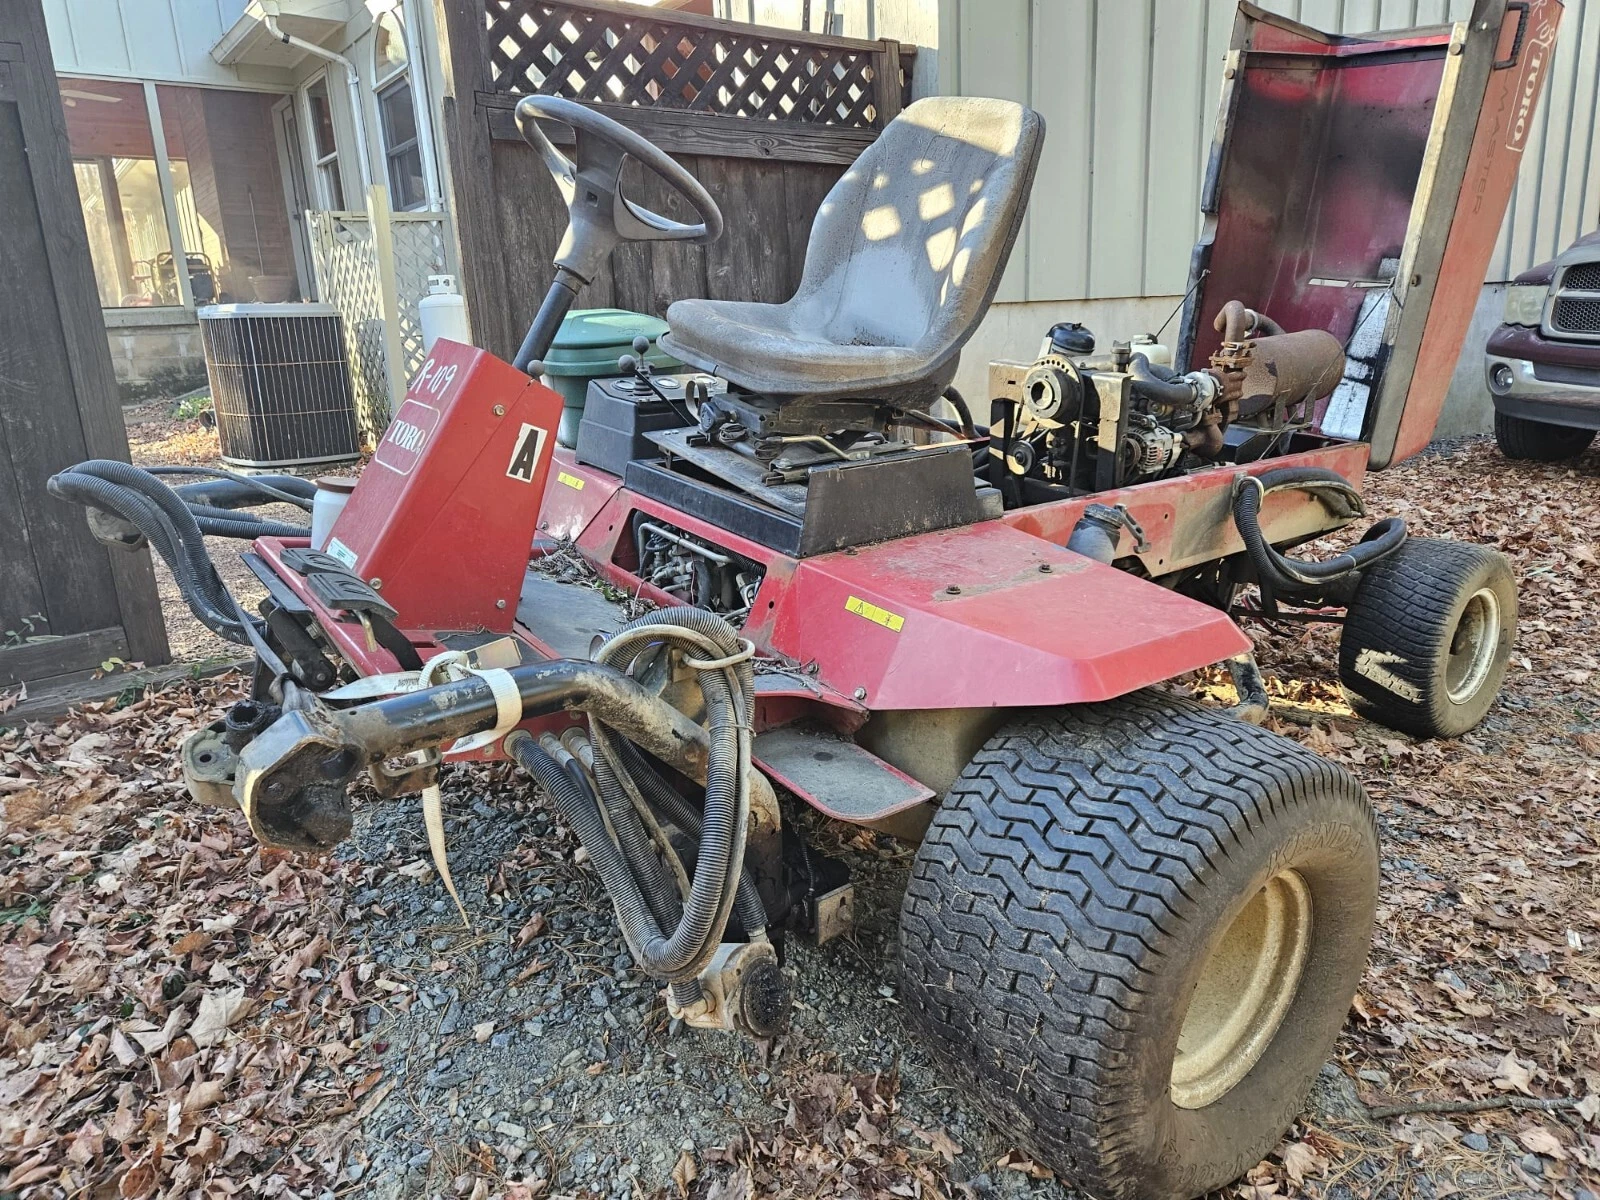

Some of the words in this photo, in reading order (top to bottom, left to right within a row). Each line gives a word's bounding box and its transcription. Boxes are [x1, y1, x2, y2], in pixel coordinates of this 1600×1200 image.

[1513, 52, 1543, 142] TORO
[410, 358, 458, 400] R-109
[387, 419, 426, 454] TORO
[508, 428, 540, 481] A
[1264, 821, 1364, 881] KENDA
